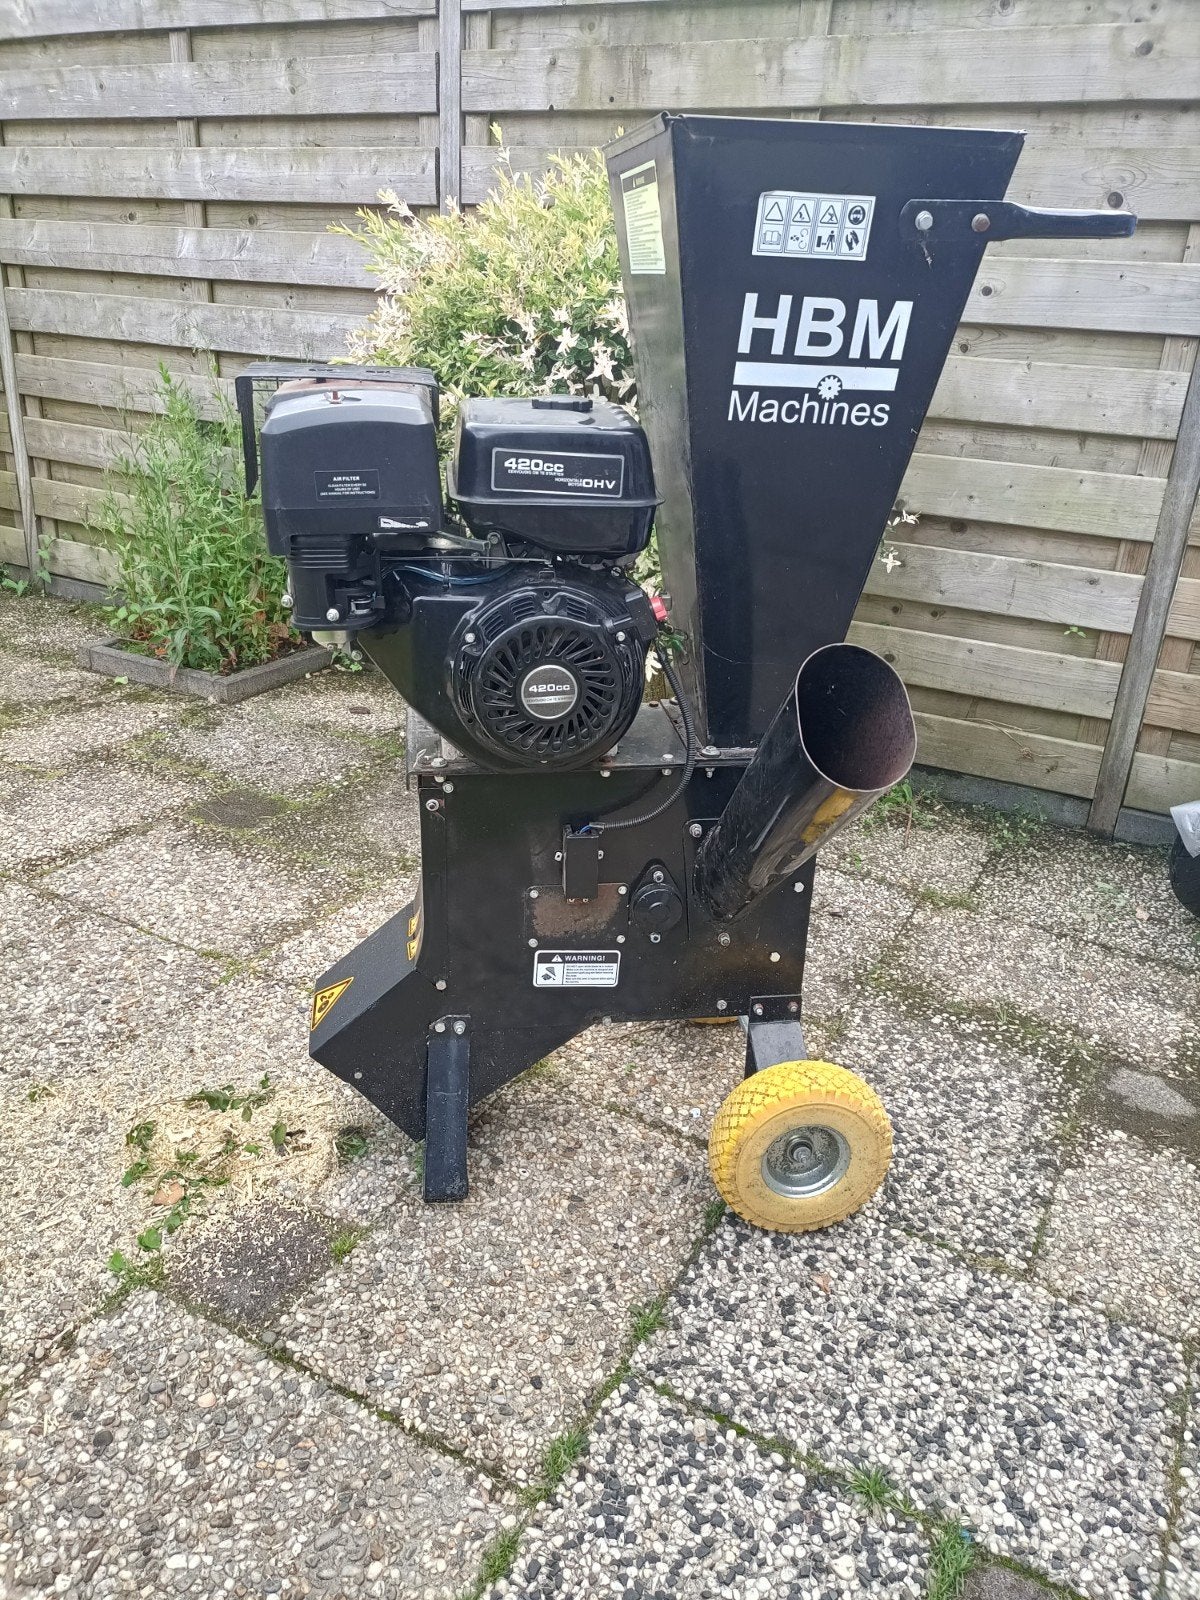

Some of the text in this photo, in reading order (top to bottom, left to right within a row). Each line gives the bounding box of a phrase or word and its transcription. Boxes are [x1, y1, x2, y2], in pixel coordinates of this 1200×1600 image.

[737, 292, 914, 361] HBM
[727, 390, 891, 427] Machines
[504, 457, 564, 472] 420cc
[582, 478, 616, 489] OHV
[528, 683, 570, 692] 420cc
